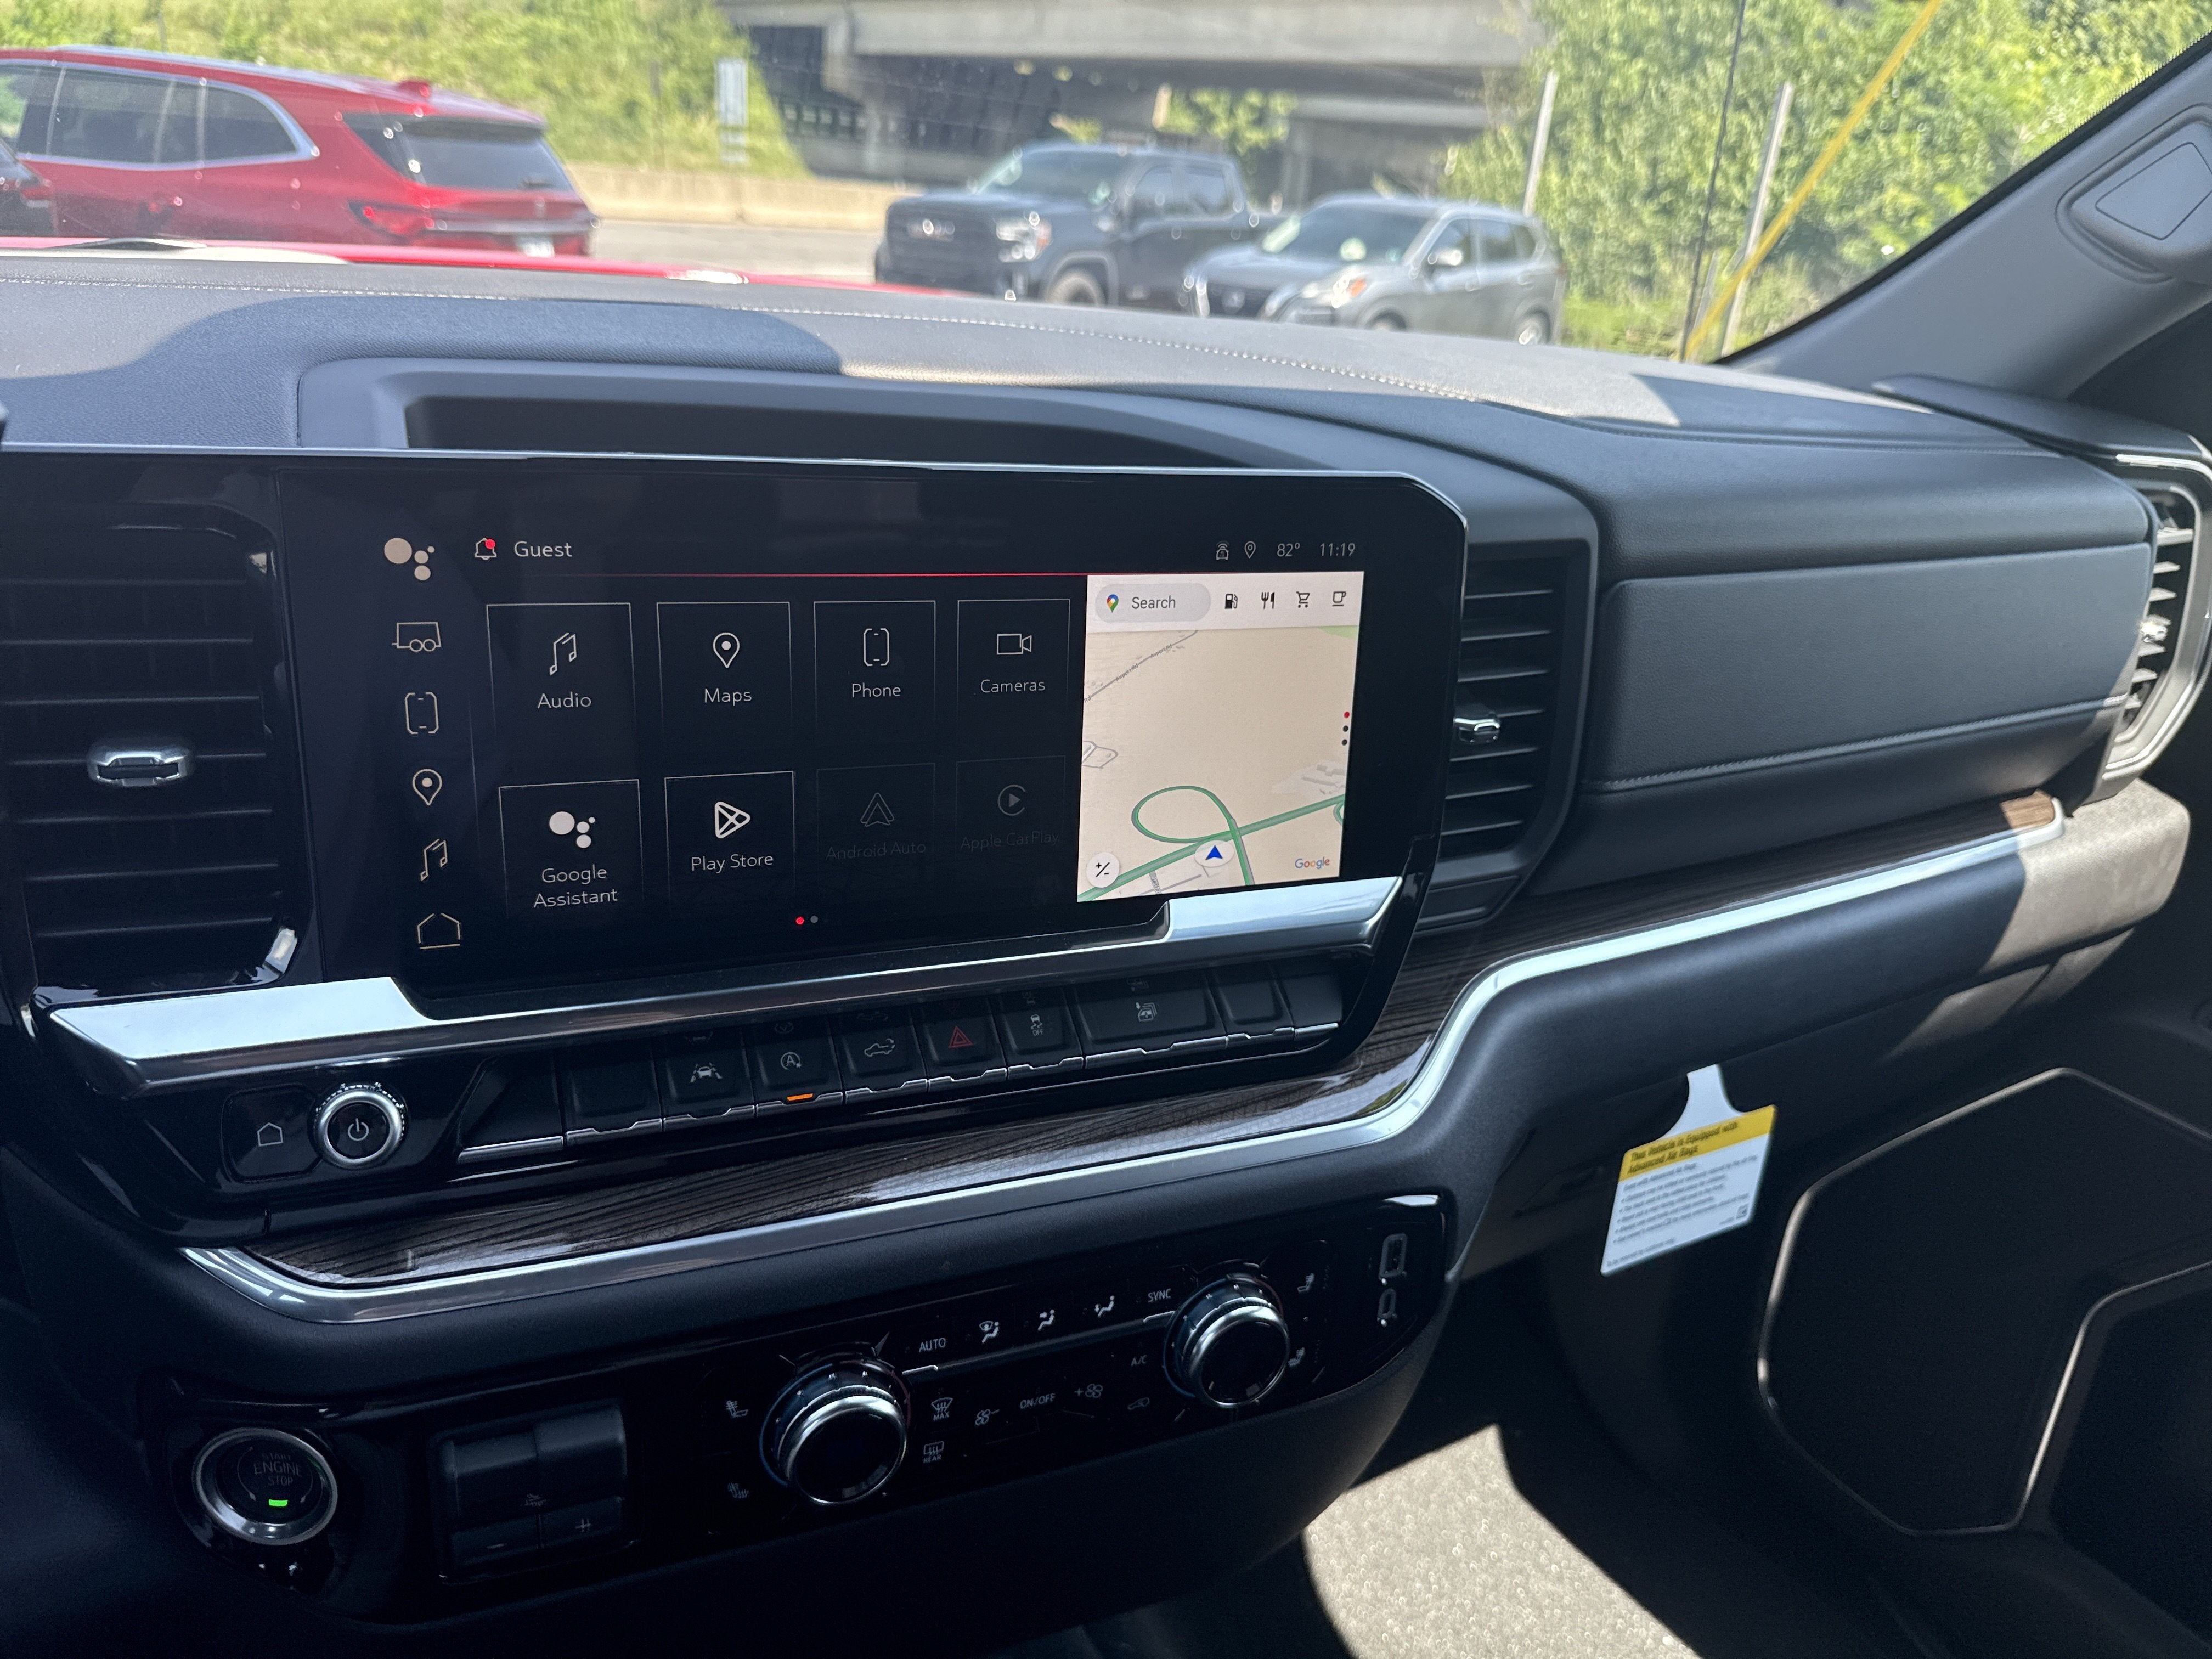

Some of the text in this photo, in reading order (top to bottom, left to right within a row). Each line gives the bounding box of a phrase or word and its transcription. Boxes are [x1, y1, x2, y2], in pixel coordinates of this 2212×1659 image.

[514, 540, 572, 557] Guest
[1320, 543, 1356, 556] 11:19
[1131, 595, 1176, 610] Search
[1150, 647, 1166, 658] Airport
[1115, 663, 1139, 681] Airport Rd
[852, 682, 901, 698] Phone
[980, 679, 1046, 693] Cameras
[537, 691, 591, 709] Audio
[704, 687, 752, 706] Maps
[960, 830, 1060, 853] Apple CarPlay
[826, 842, 927, 861] Android Auto
[691, 854, 774, 872] Play Store
[1294, 856, 1330, 870] Google
[541, 864, 607, 885] Google
[533, 889, 618, 909] Assistant
[1032, 1028, 1044, 1037] OFF
[1148, 1288, 1171, 1302] SYNC
[919, 1337, 946, 1352] AUTO
[1131, 1355, 1147, 1367] A/C
[1019, 1392, 1056, 1409] ON/OFF
[933, 1412, 950, 1421] MAX
[923, 1454, 942, 1463] REAR
[253, 1462, 302, 1476] ENGINE
[268, 1475, 294, 1486] STOP
